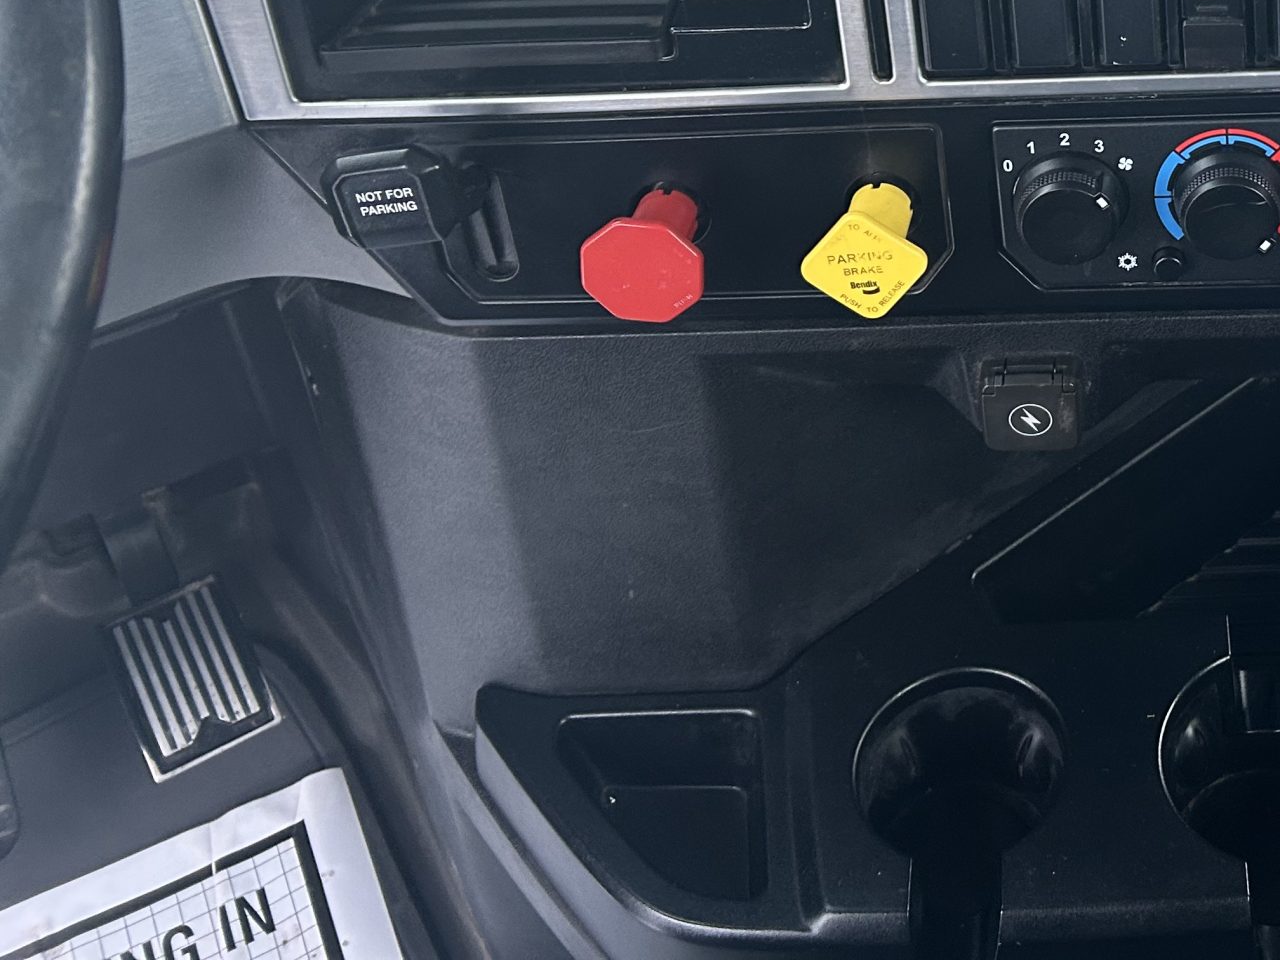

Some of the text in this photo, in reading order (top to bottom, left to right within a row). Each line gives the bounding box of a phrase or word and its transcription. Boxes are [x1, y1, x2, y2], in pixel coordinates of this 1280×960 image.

[1059, 133, 1071, 146] 2
[1093, 139, 1105, 153] 3
[1026, 141, 1035, 154] 1
[1002, 159, 1013, 172] 0
[355, 187, 414, 203] NOT FOR
[360, 200, 418, 216] PARKING
[843, 265, 884, 277] BRAKE
[850, 280, 878, 289] Bendix
[840, 293, 862, 309] PUSH
[878, 279, 905, 307] RELEASE
[219, 886, 276, 952] IN
